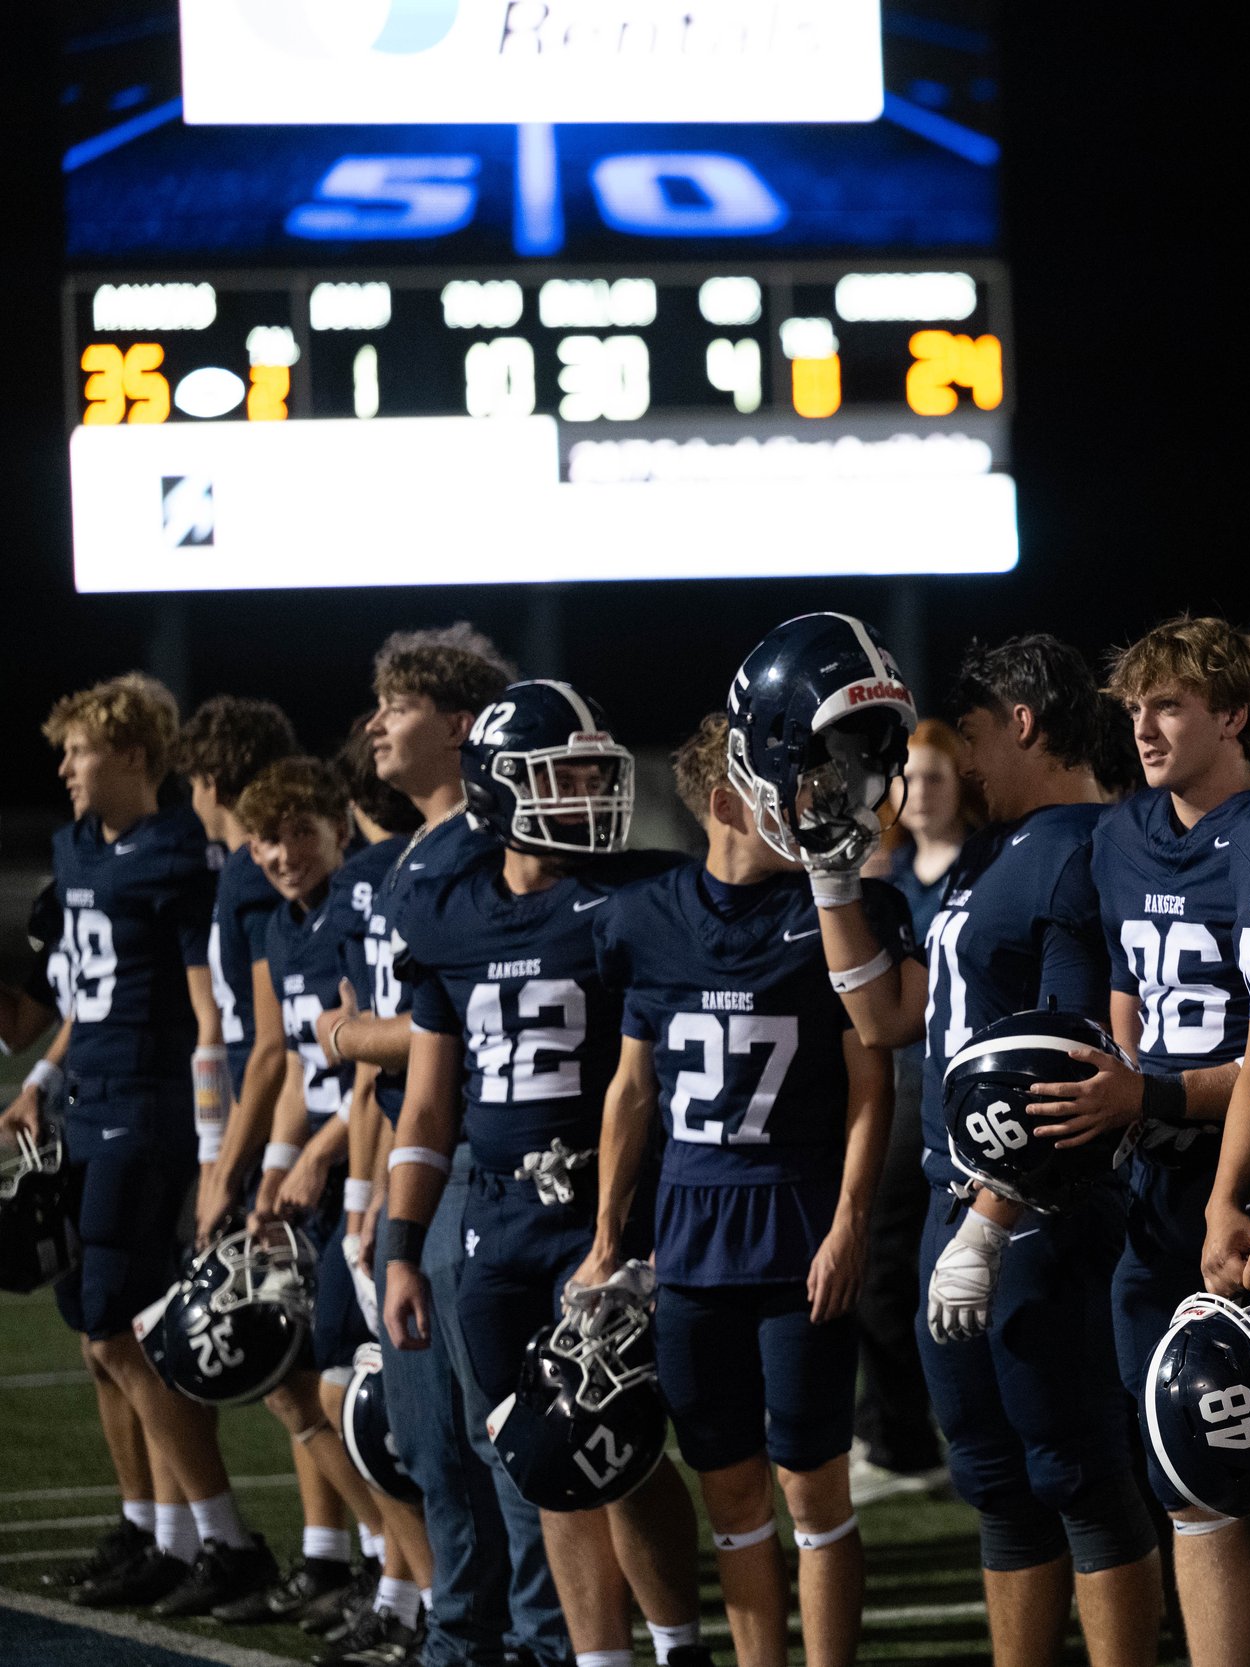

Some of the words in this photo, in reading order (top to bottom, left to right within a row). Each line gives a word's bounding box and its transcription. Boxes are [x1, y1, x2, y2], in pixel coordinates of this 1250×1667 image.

[82, 343, 170, 424] 35
[353, 344, 379, 419] 1
[557, 335, 649, 422] 30
[706, 338, 761, 414] 4
[906, 330, 1003, 416] 24
[468, 702, 516, 746] 42
[1144, 894, 1186, 916] RANGERS
[488, 958, 541, 980] RANGERS
[702, 991, 754, 1011] RANGERS
[1120, 920, 1231, 1054] 96
[466, 978, 587, 1103] 42
[668, 1012, 799, 1145] 27
[966, 1100, 1028, 1160] 96
[189, 1315, 245, 1377] 32
[572, 1424, 634, 1489] 27
